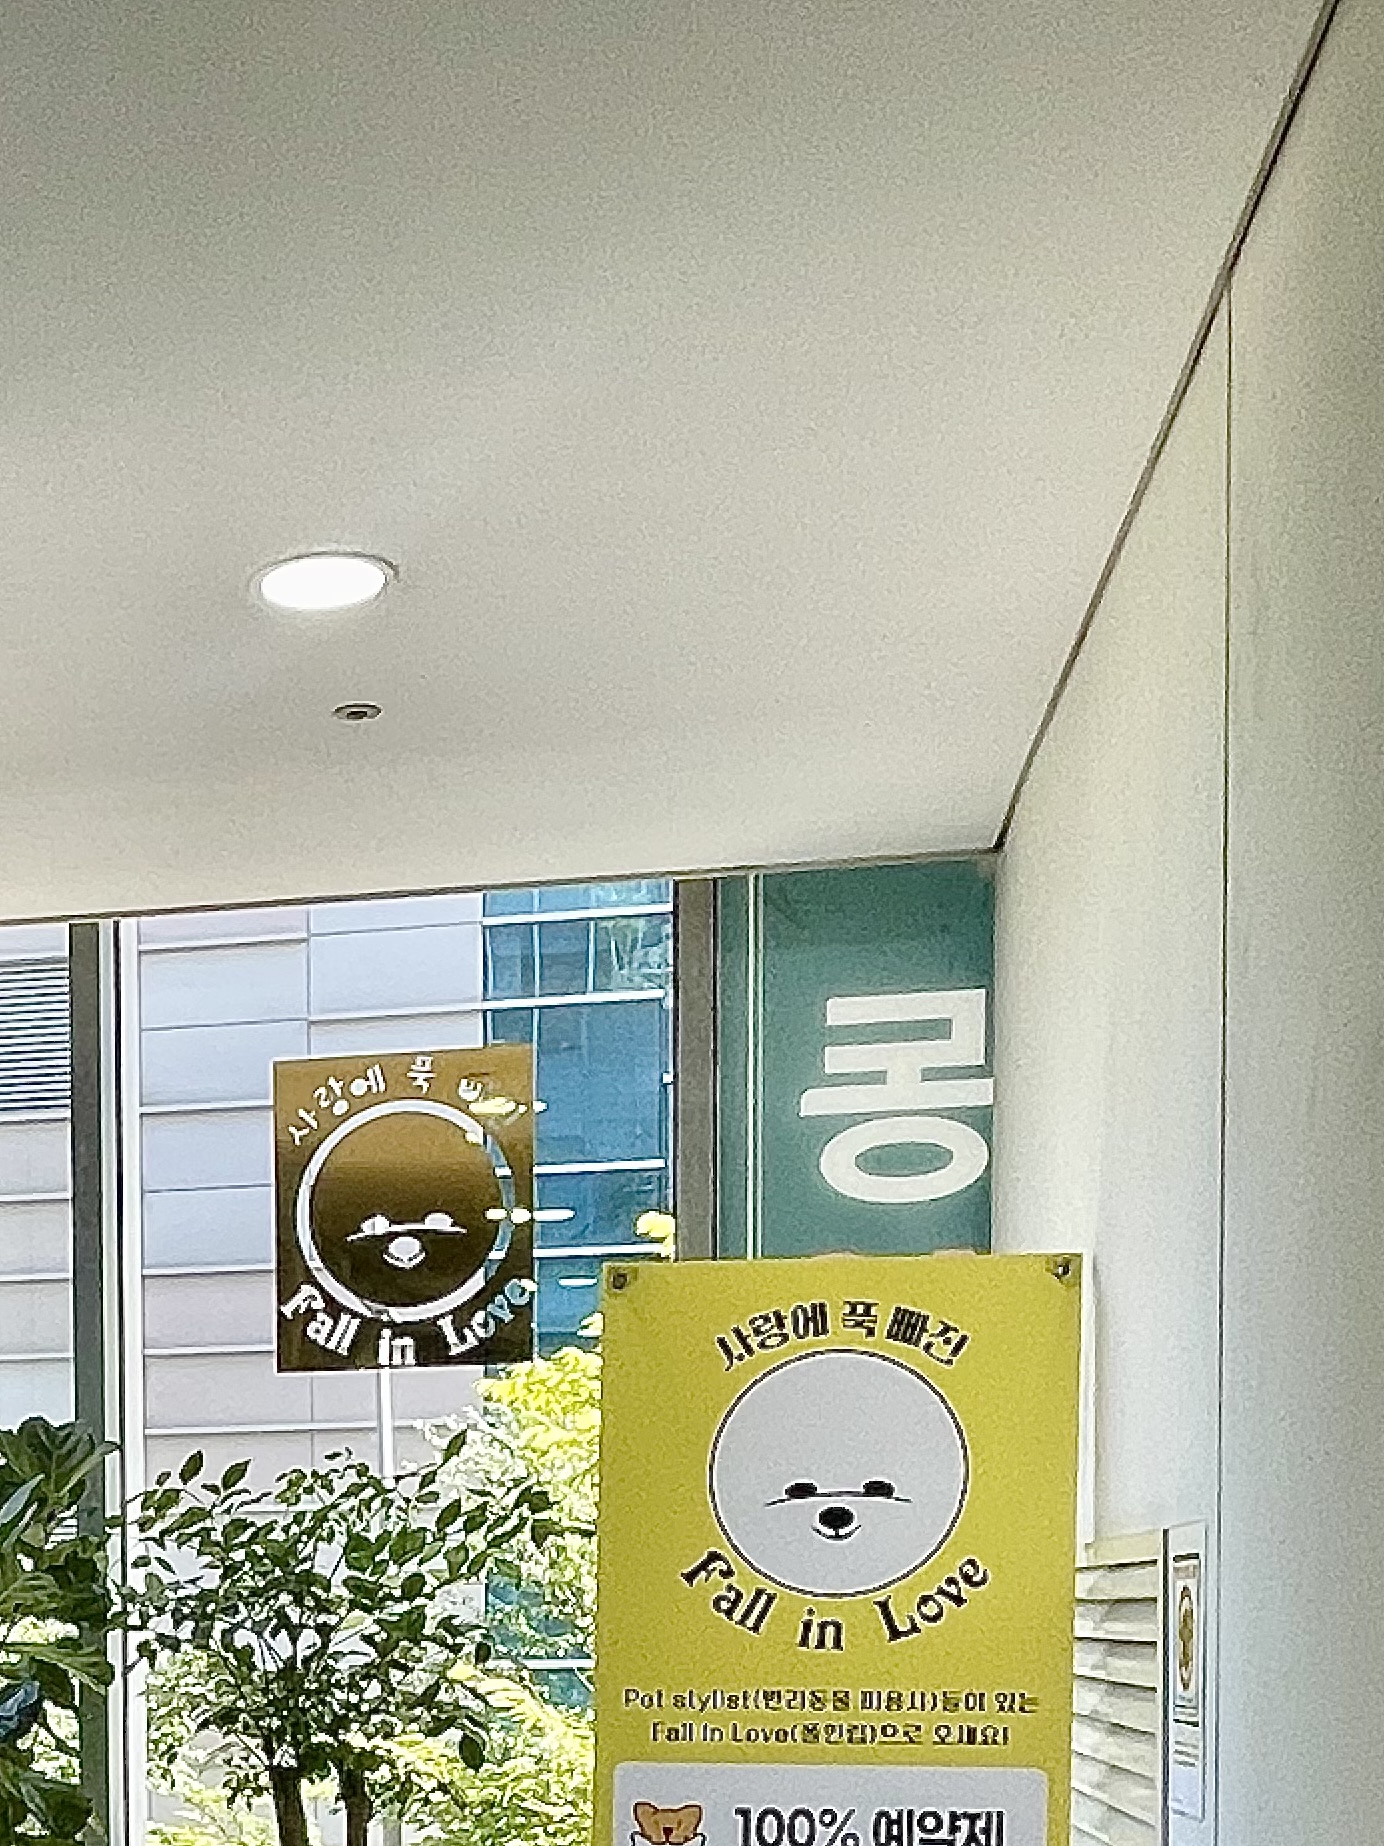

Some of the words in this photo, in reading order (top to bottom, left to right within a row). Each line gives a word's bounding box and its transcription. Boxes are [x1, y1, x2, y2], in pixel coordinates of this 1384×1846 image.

[288, 1064, 386, 1145] 사랑에
[280, 1283, 362, 1357] Fall
[377, 1327, 416, 1366] in
[436, 1279, 537, 1357] Love
[714, 1301, 830, 1371] 사랑에
[842, 1300, 878, 1339] 푹
[886, 1305, 970, 1367] 빠진
[680, 1550, 777, 1635] Fall
[797, 1608, 844, 1651] in
[873, 1556, 990, 1643] Love
[652, 1720, 695, 1743] Fall
